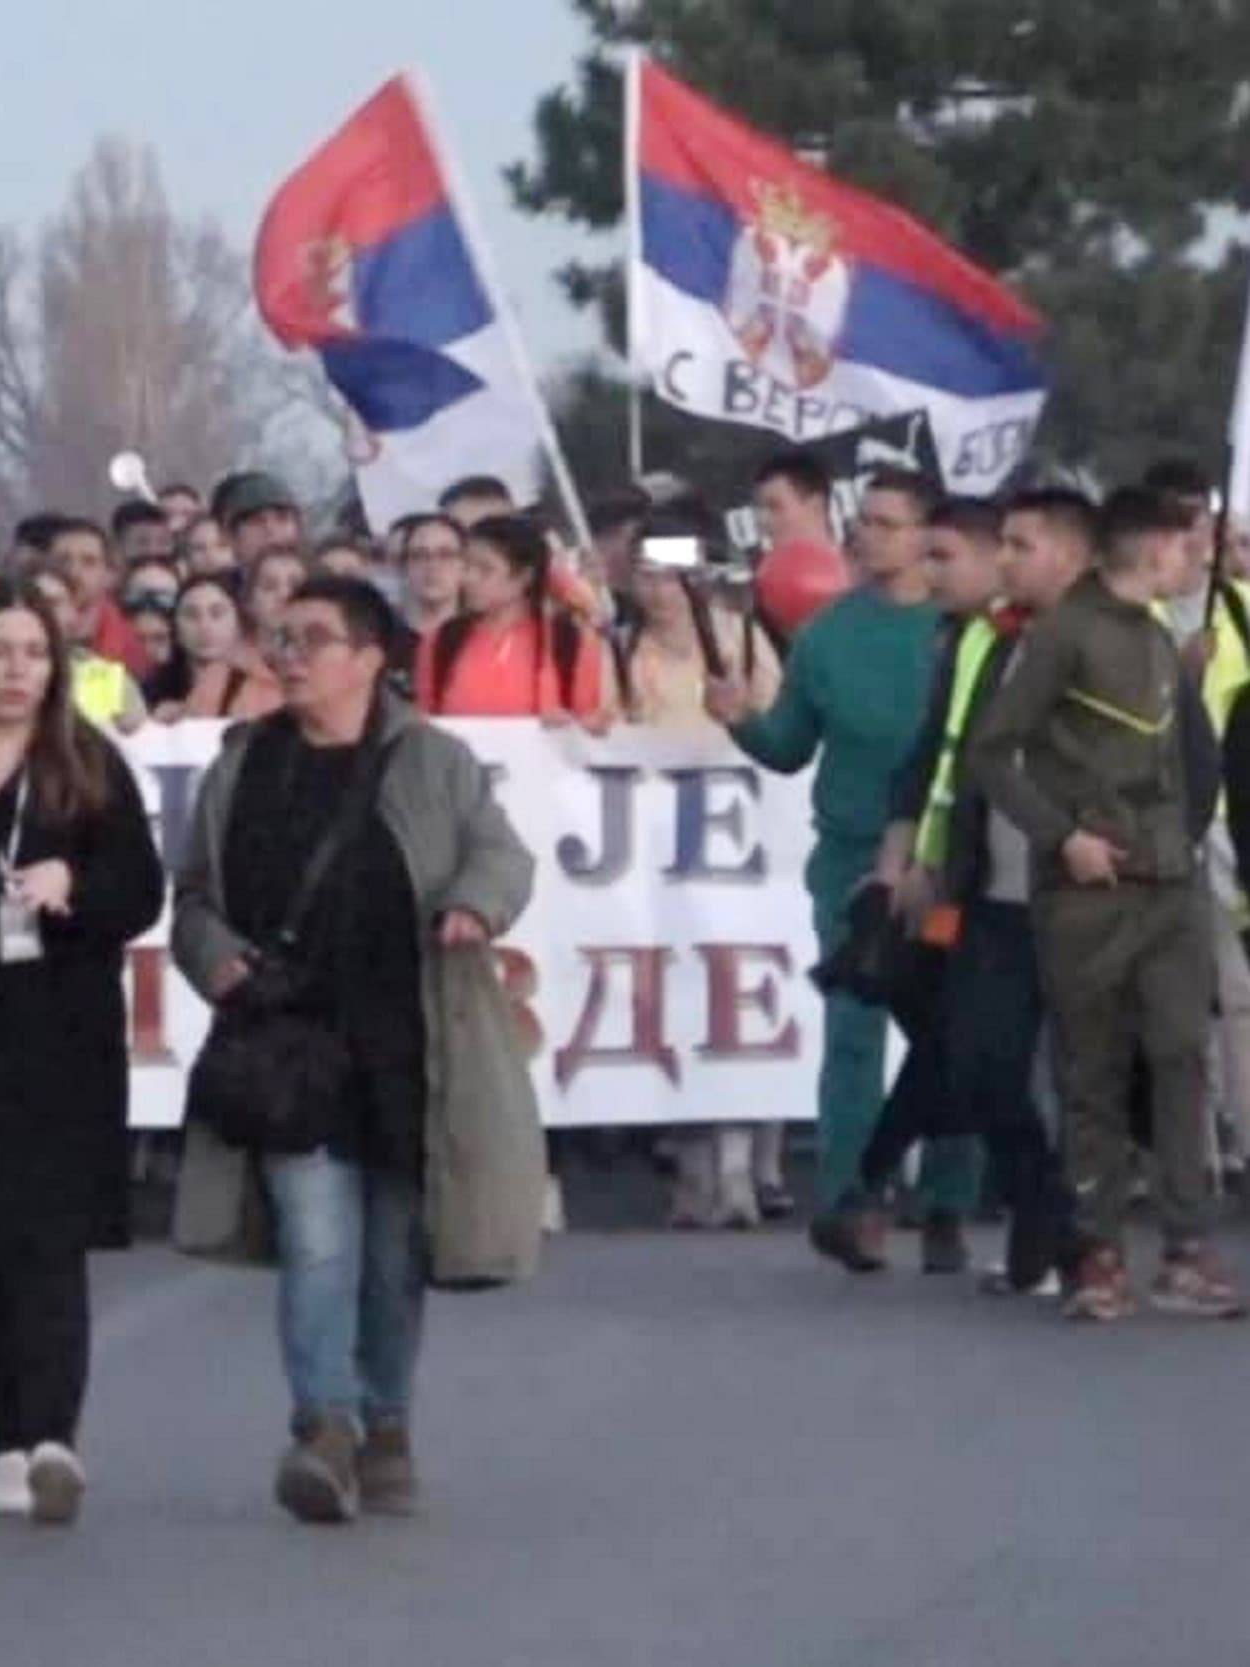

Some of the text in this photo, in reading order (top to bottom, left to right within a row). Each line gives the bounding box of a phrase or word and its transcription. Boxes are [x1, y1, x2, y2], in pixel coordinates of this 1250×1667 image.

[664, 350, 693, 402] С
[723, 358, 866, 438] ВЕРО
[554, 763, 768, 886] ЈЕ
